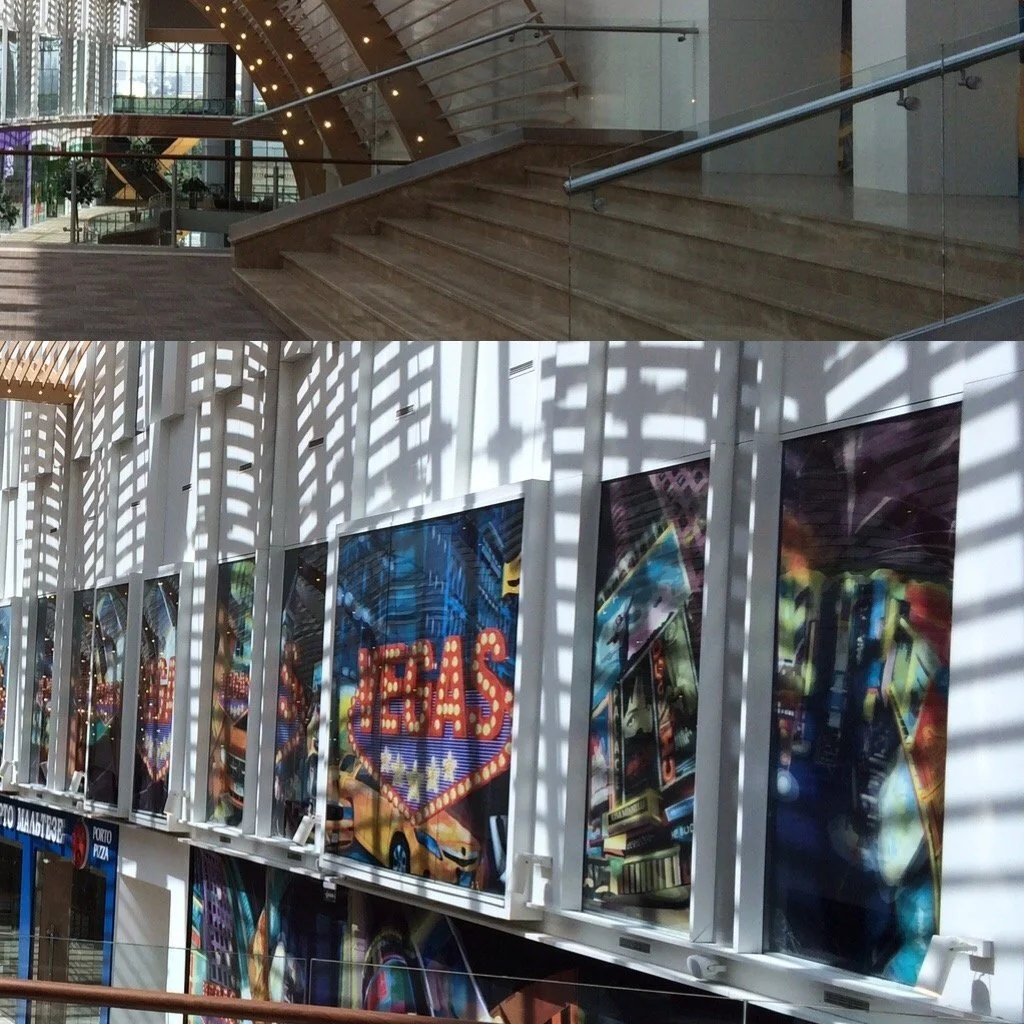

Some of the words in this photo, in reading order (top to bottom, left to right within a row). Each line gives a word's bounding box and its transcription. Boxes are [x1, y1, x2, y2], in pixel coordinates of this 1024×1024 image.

[16, 807, 65, 844] МАЛЬТЕЗЕ
[93, 826, 112, 844] PORTO
[93, 843, 109, 861] PIZZA
